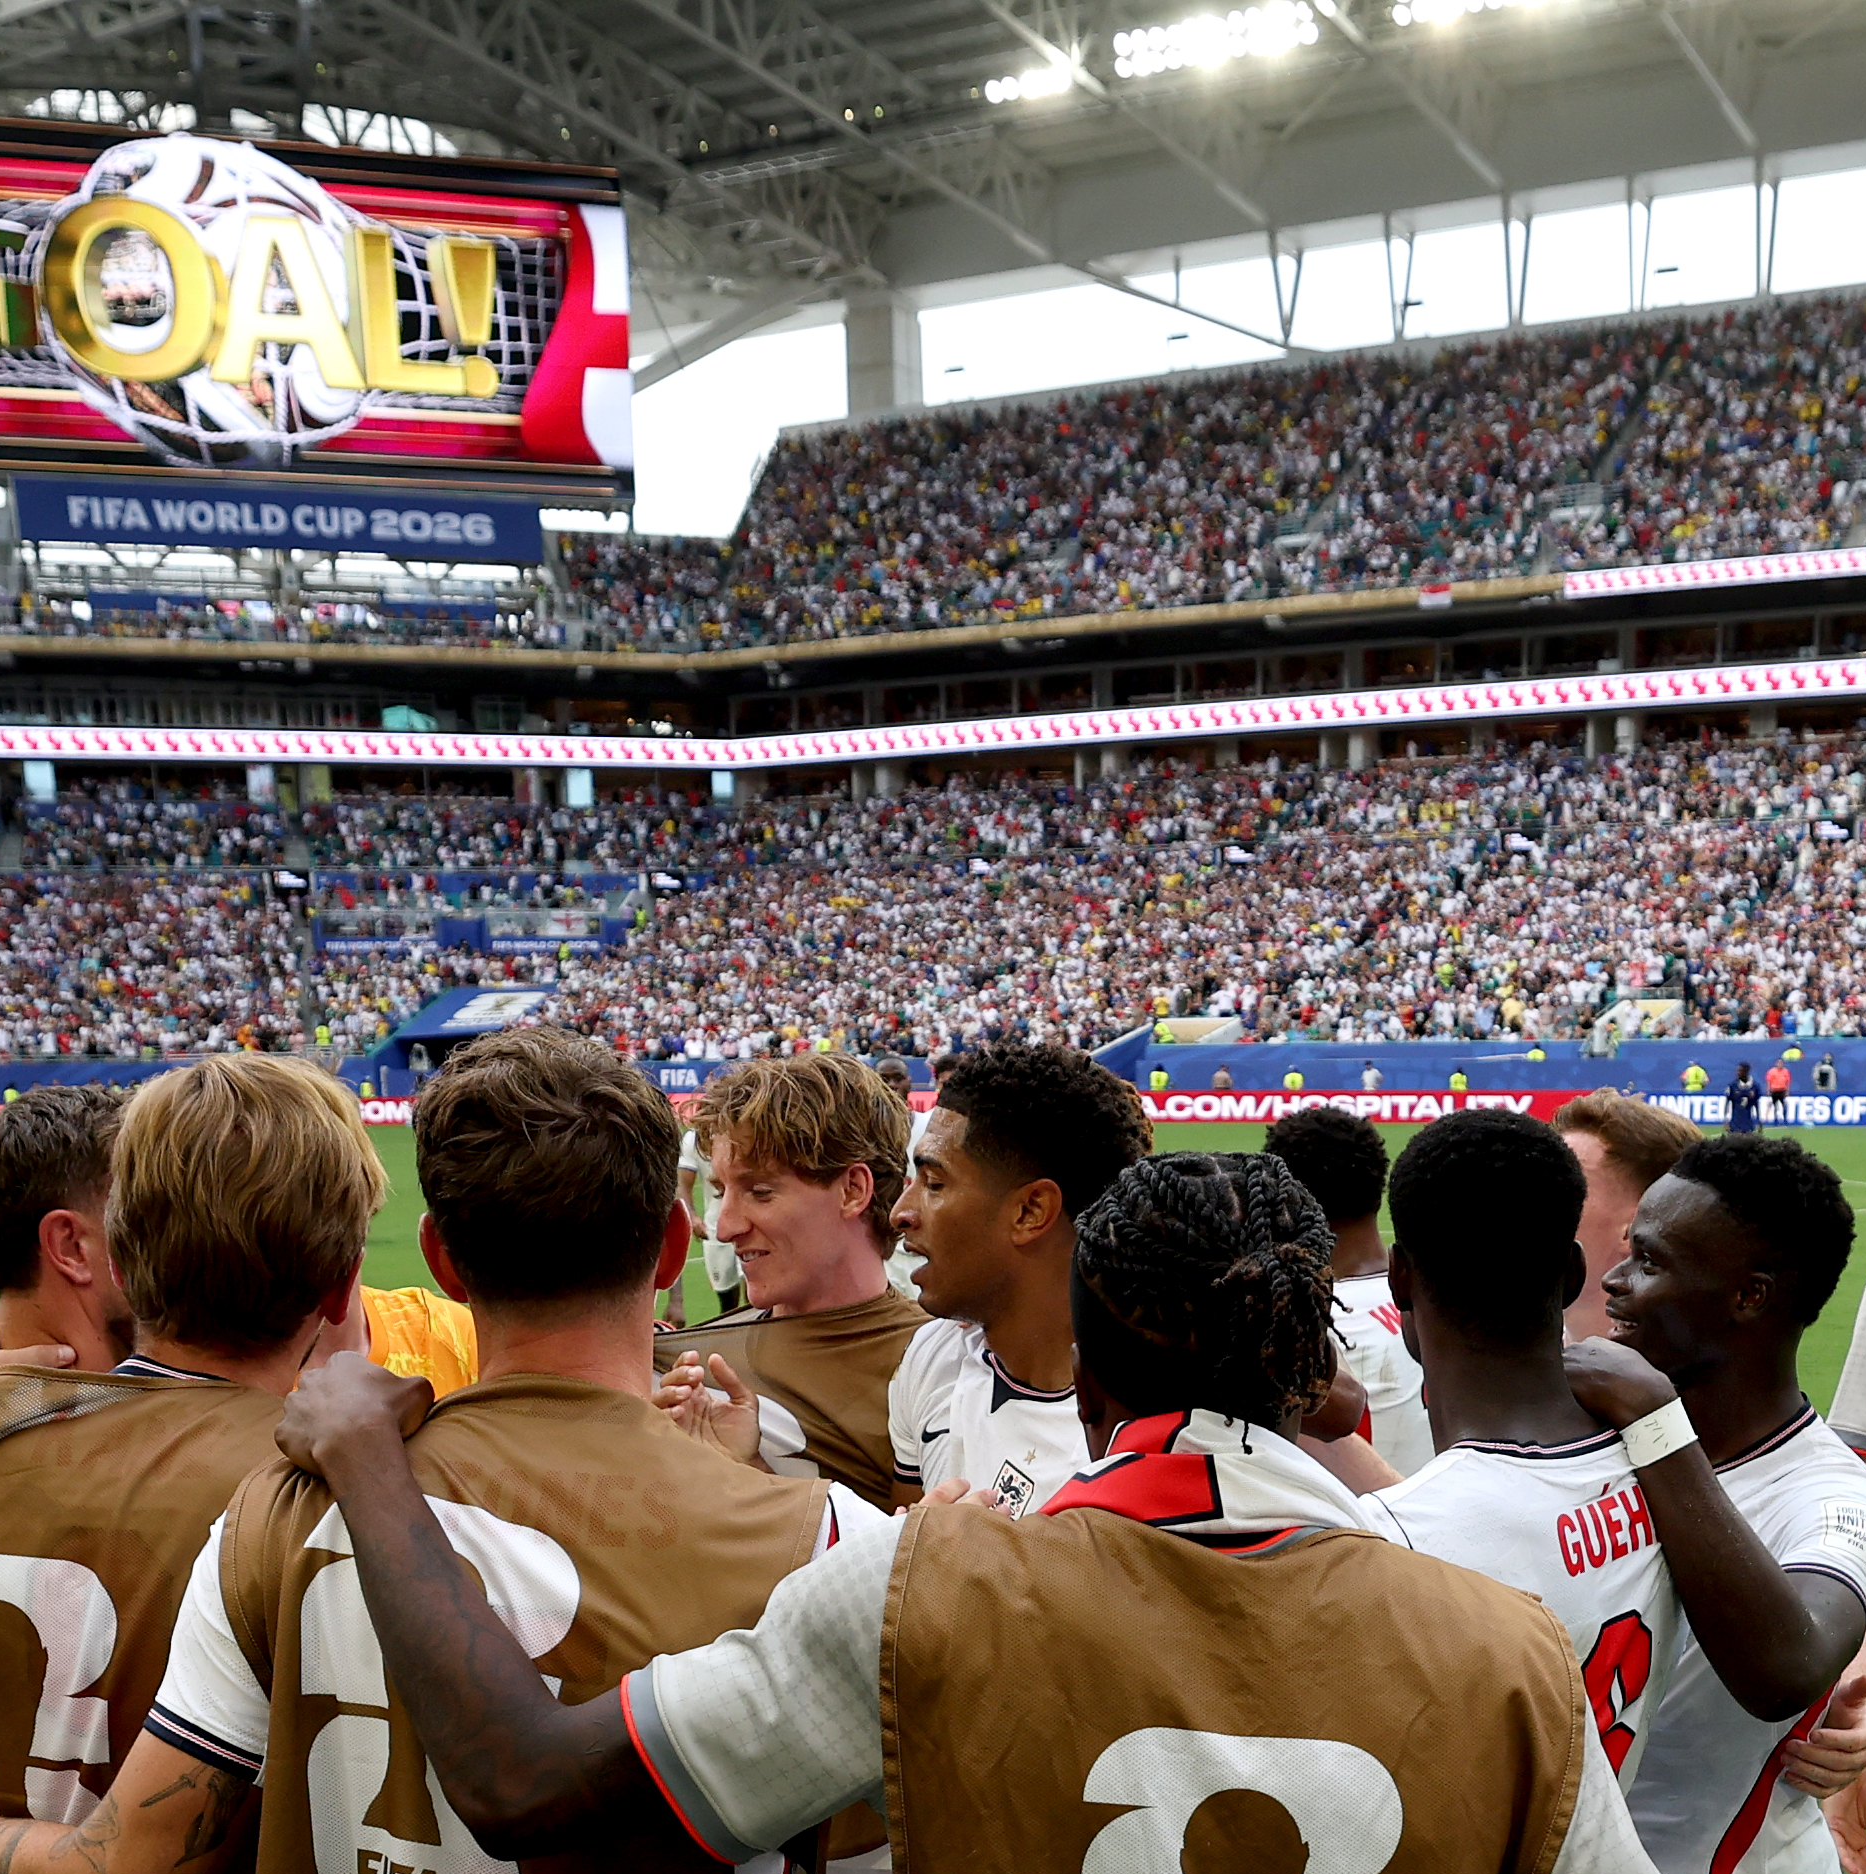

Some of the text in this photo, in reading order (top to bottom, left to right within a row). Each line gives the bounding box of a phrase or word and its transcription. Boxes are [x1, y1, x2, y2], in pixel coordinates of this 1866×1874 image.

[66, 494, 495, 545] FIFA WORLD CUP 2026
[660, 1068, 700, 1087] FIFA
[1847, 1538, 1864, 1551] FIFA
